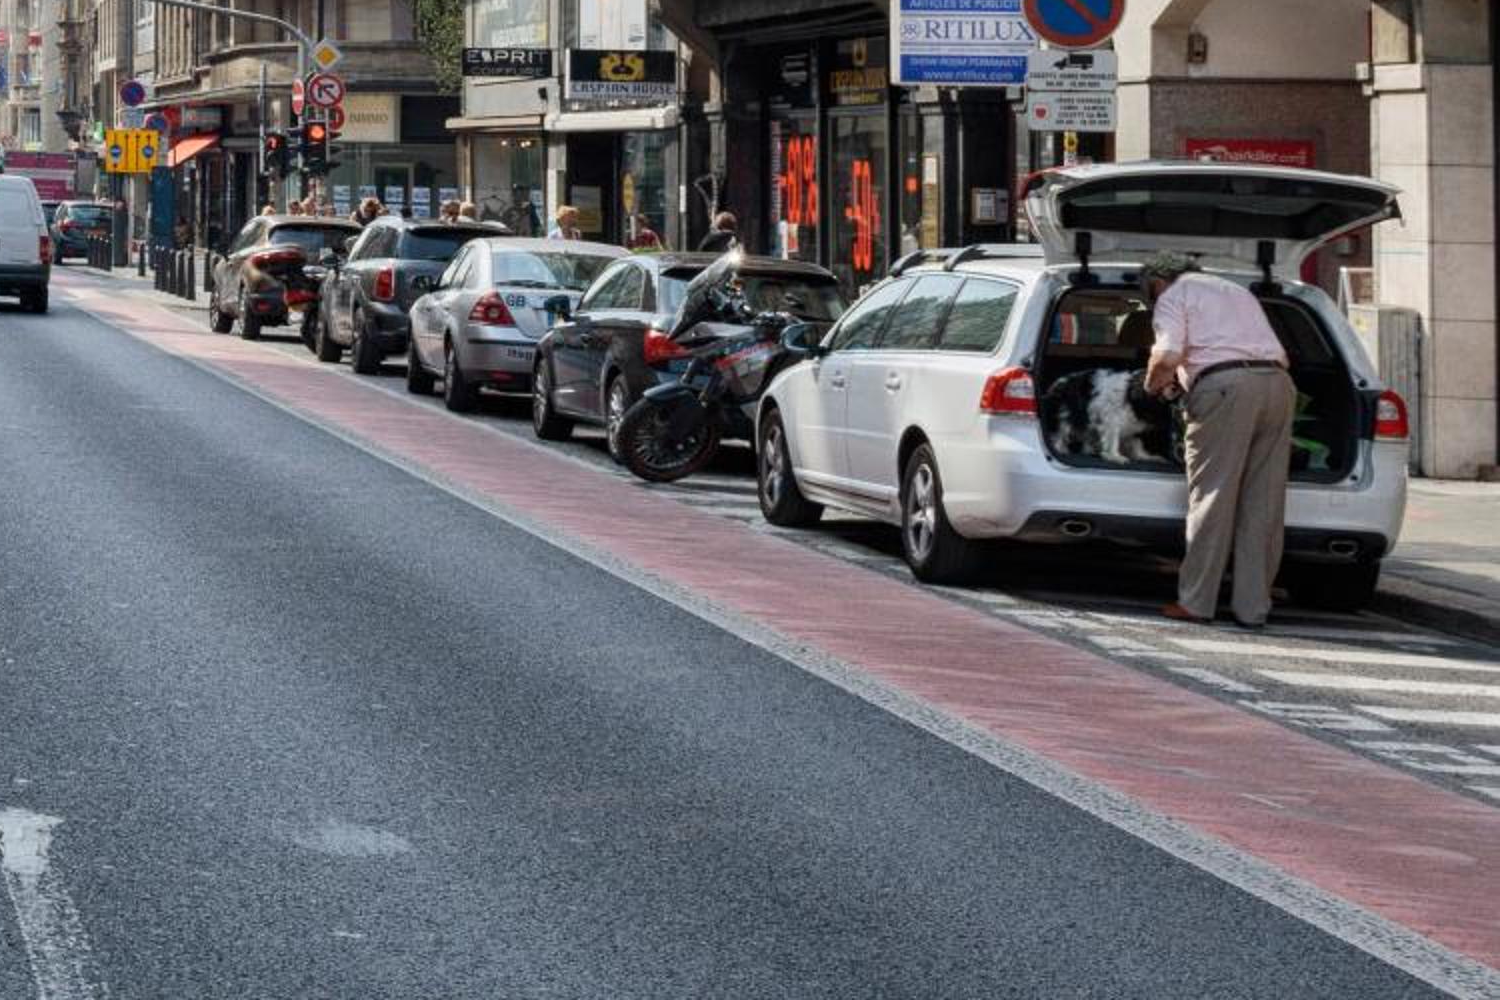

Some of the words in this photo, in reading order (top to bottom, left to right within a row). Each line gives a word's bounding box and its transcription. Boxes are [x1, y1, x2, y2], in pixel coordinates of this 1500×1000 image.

[924, 20, 1034, 41] RITILUX
[467, 49, 549, 64] ESPRIT
[572, 82, 629, 93] CASPIAN
